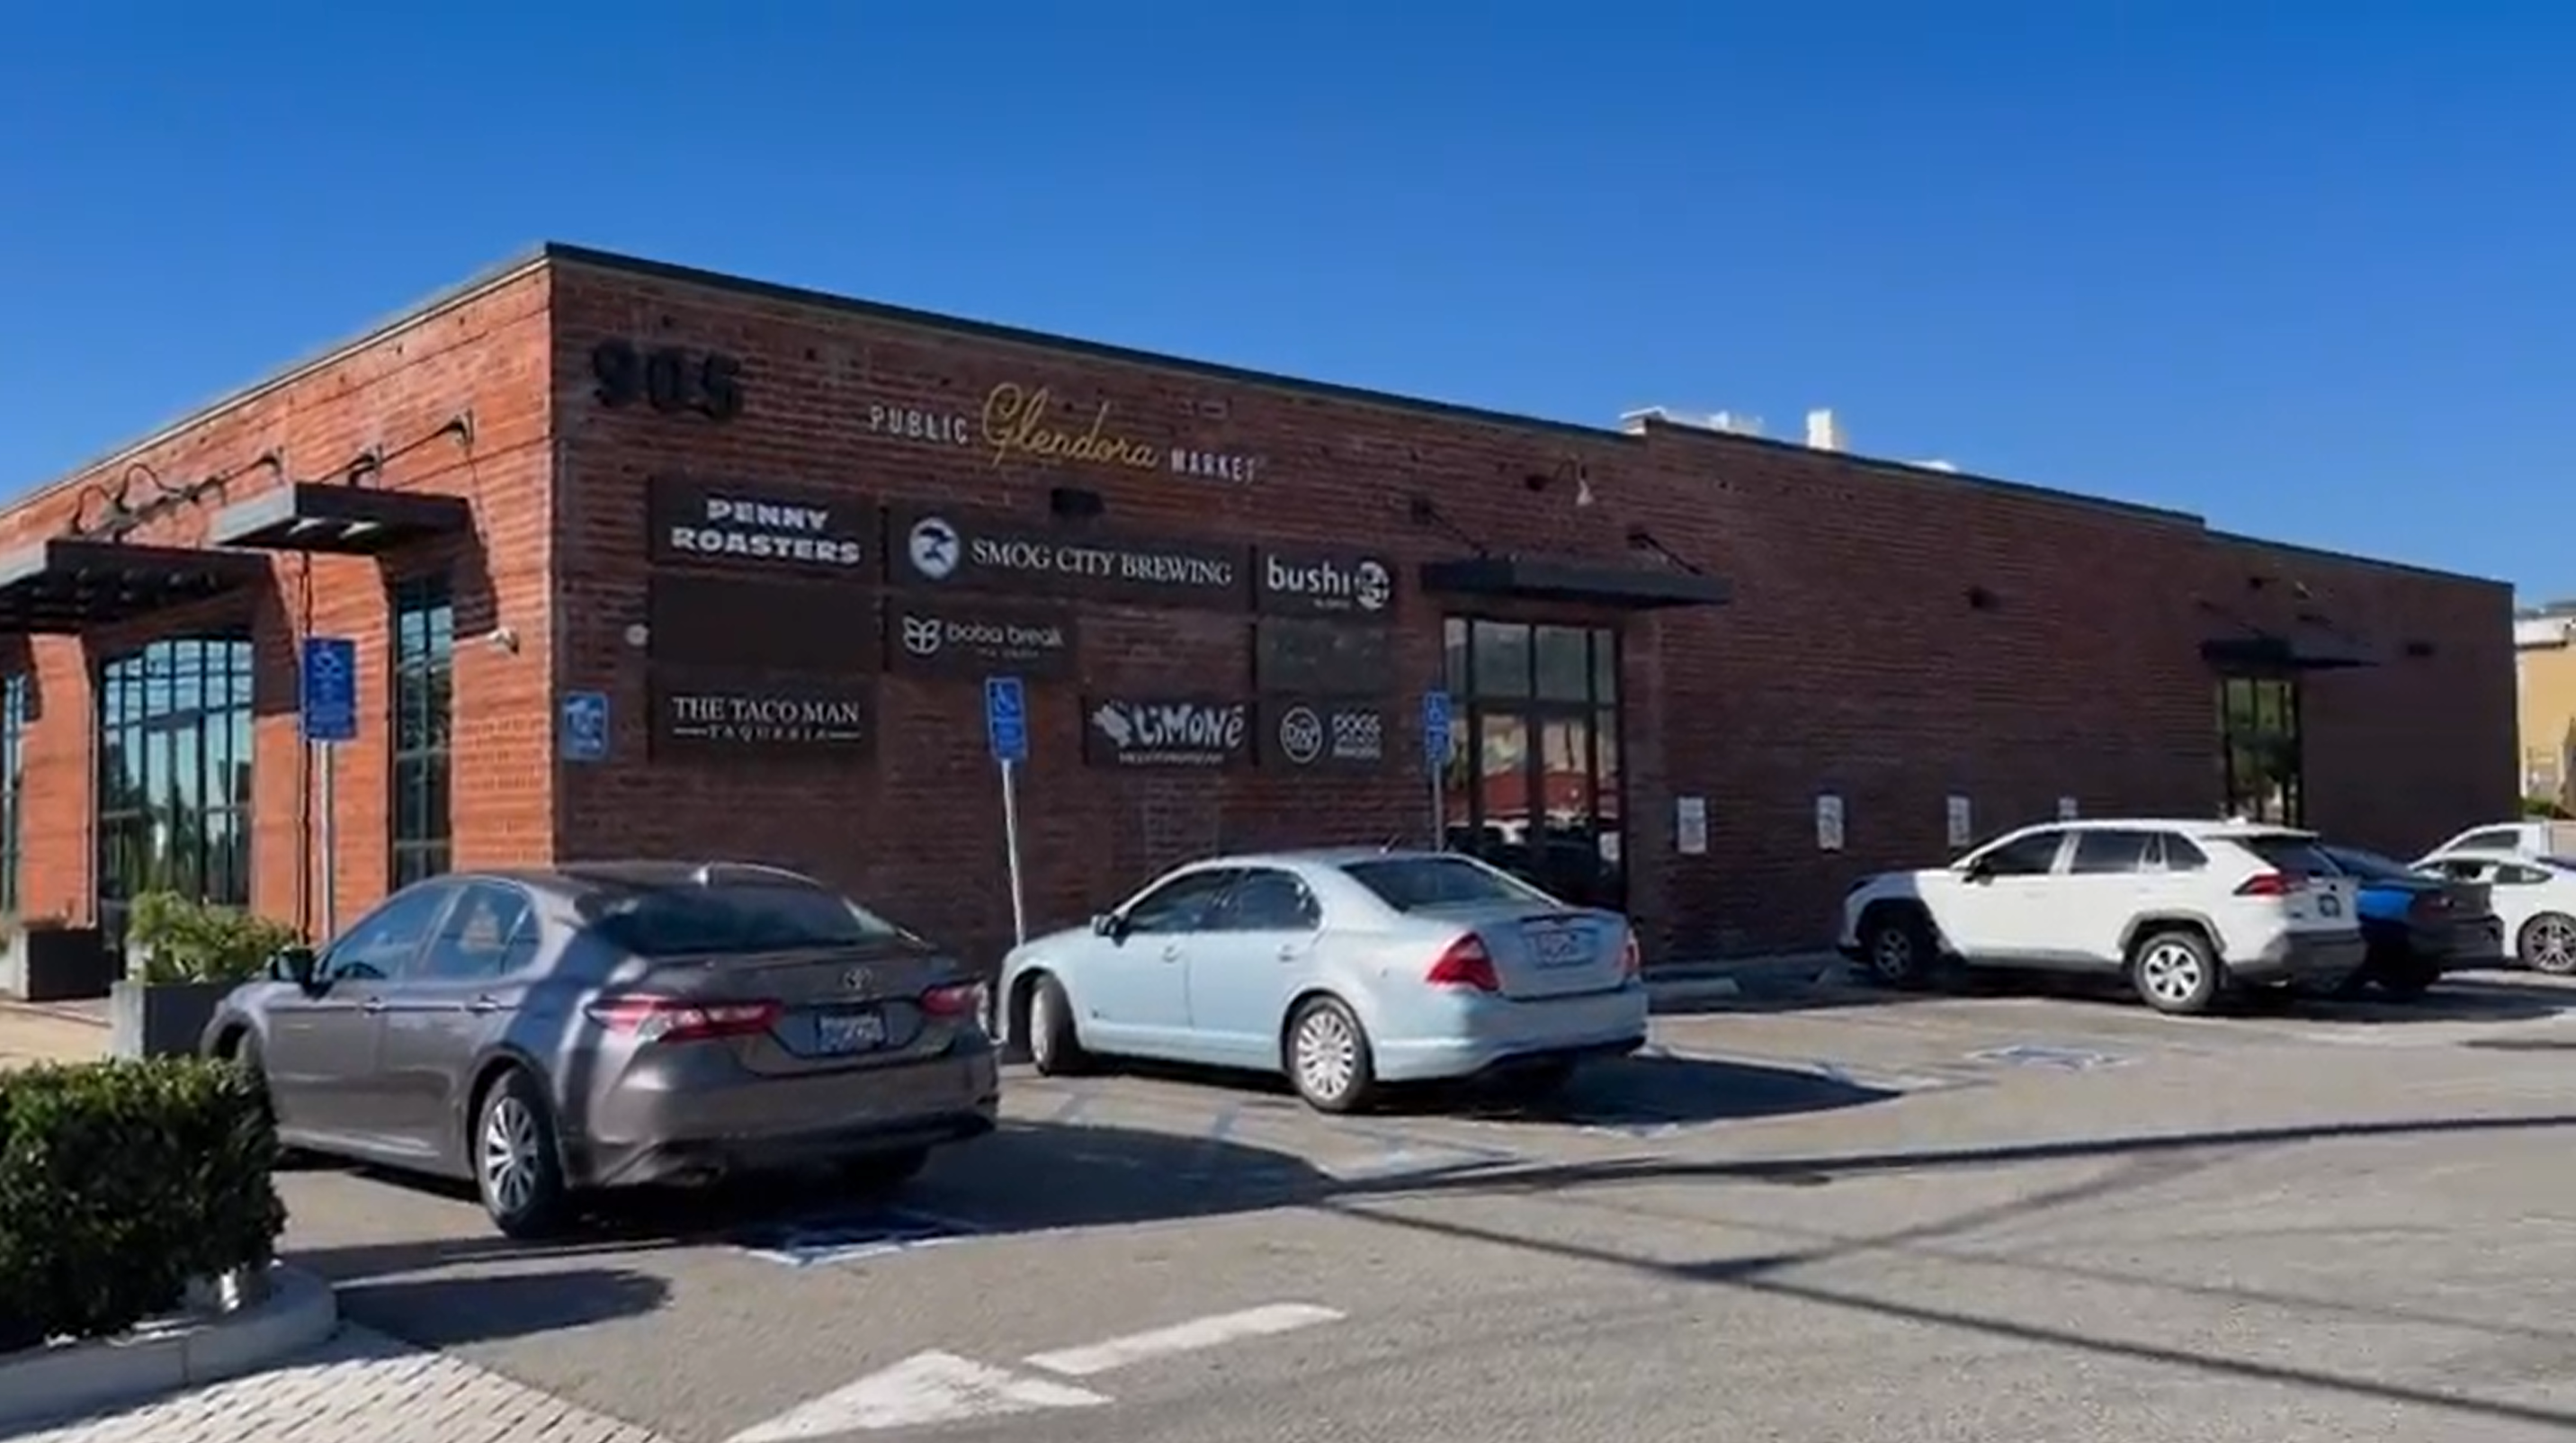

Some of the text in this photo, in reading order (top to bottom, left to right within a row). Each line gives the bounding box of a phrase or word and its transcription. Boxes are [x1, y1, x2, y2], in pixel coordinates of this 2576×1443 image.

[868, 382, 1257, 483] PUBLIC Glendora MARKET
[706, 498, 828, 530] PENNY
[671, 526, 860, 564] ROASTERS
[971, 539, 1233, 586] SMOG CITY BREWING
[1267, 555, 1350, 596] bushi
[946, 622, 1064, 647] boba break
[672, 696, 859, 723] THE TACO MAN
